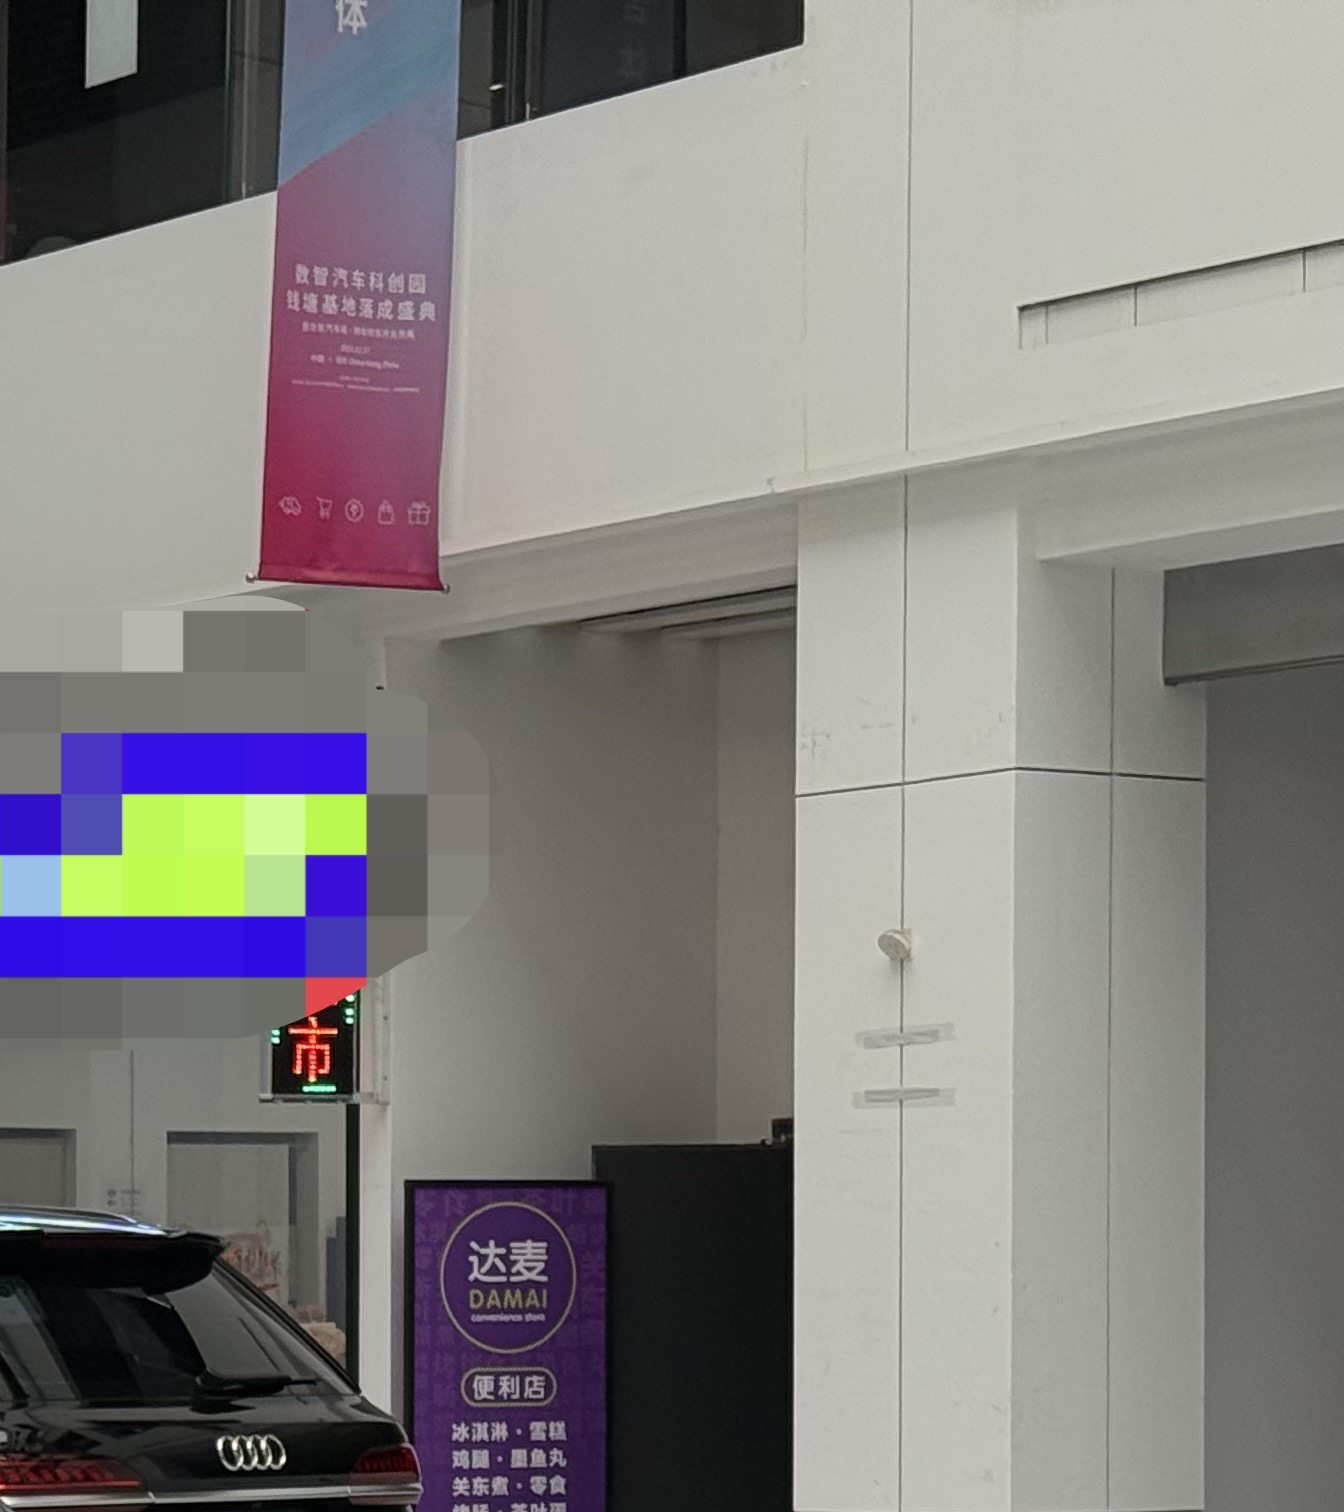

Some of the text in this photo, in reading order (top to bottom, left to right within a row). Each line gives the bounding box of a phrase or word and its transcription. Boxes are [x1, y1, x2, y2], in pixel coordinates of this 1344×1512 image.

[335, 0, 369, 35] 体
[295, 263, 426, 294] 数智汽车科创园
[286, 289, 437, 322] 钱塘基地落成盛典
[287, 1015, 339, 1083] 市
[467, 1239, 549, 1283] 达麦
[468, 1288, 548, 1310] DAMAI
[472, 1374, 547, 1401] 便利店
